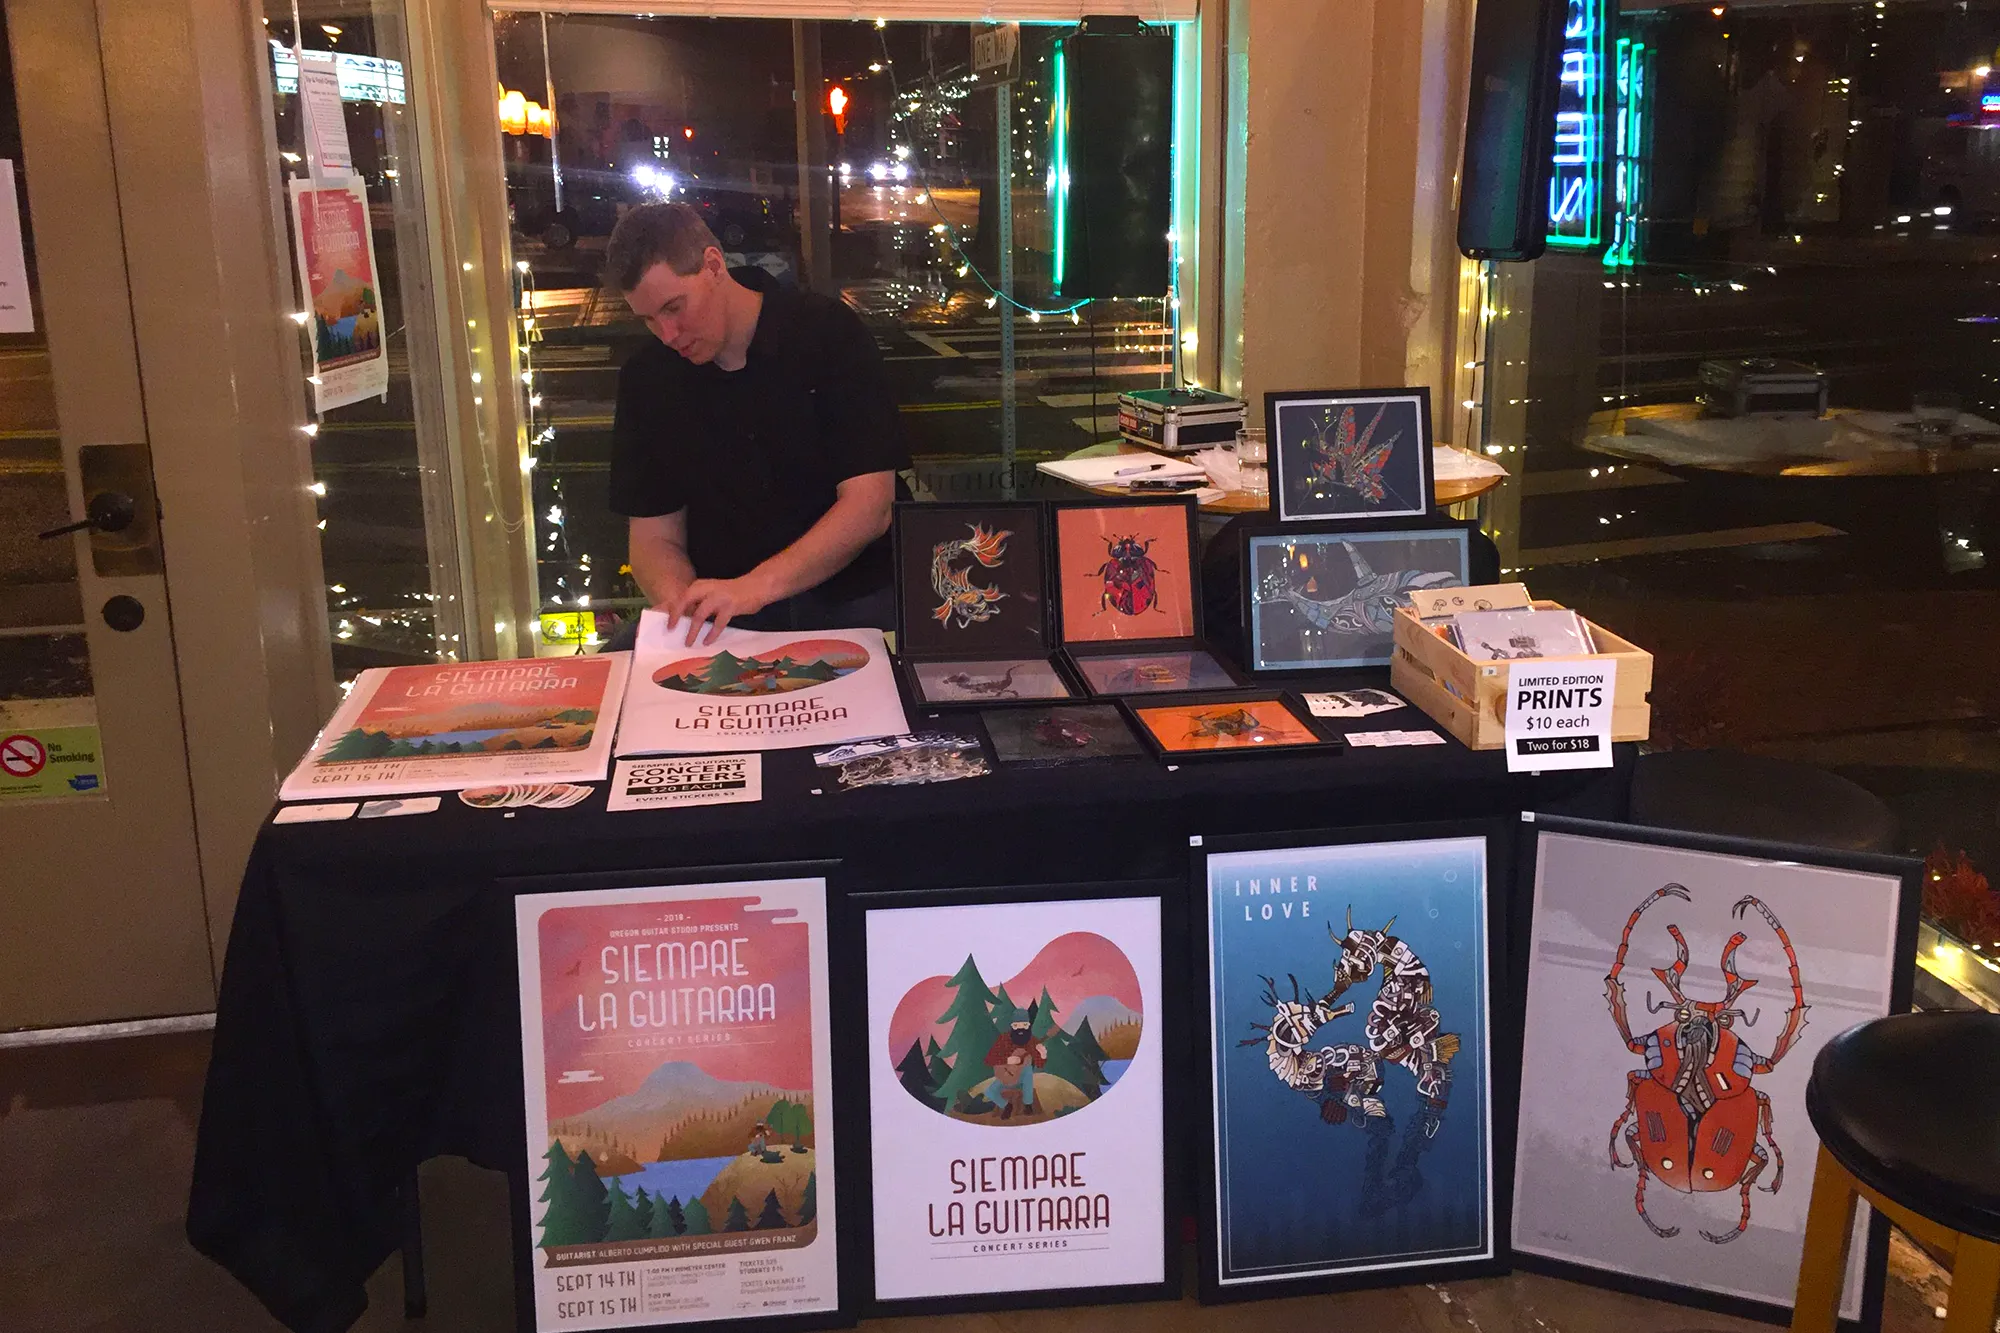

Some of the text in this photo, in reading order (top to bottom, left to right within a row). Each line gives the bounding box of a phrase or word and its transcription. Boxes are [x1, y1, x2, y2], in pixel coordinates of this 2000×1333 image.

[976, 31, 1008, 65] ONE WAY
[435, 666, 561, 685] SIEMPRE
[1519, 675, 1604, 687] LIMITED EDITION
[405, 685, 441, 698] LA
[449, 677, 578, 697] GUITARRA
[698, 696, 824, 717] SIEMPRE
[1517, 687, 1603, 711] PRINTS
[675, 707, 848, 730] LA GUITARRA
[1526, 715, 1590, 731] $10 each
[48, 743, 62, 752] No
[1527, 739, 1590, 751] Two for $18
[49, 752, 95, 764] Smoking
[312, 772, 395, 784] SEPT 15 TH
[627, 771, 746, 787] POSTERS
[629, 763, 746, 777] CONCERT
[650, 783, 723, 794] $20 EACH
[672, 792, 720, 800] STICKERS
[1235, 875, 1318, 897] INNER
[663, 913, 684, 922] 2018
[1245, 901, 1310, 922] LOVE
[609, 923, 739, 938] OREGON GUITAR STUDIO PRESENTS
[601, 937, 749, 984] SIEMPRE
[578, 983, 776, 1032] LA GUITARRA
[627, 1033, 732, 1048] CONCERT SERIES
[950, 1152, 1086, 1194] SIEMPRE
[929, 1194, 1110, 1237] LA GUITARRA
[556, 1235, 797, 1261] GUITARIST ALBERTO CUMPLIDO WITH SPECIAL GUEST GWEN FRANZ
[973, 1240, 1068, 1253] CONCERT SERIES
[557, 1274, 592, 1292] SEPT
[598, 1271, 615, 1288] 14
[619, 1271, 635, 1287] TH
[558, 1300, 594, 1319] SEPT
[600, 1299, 615, 1315] 15
[620, 1297, 637, 1314] TH
